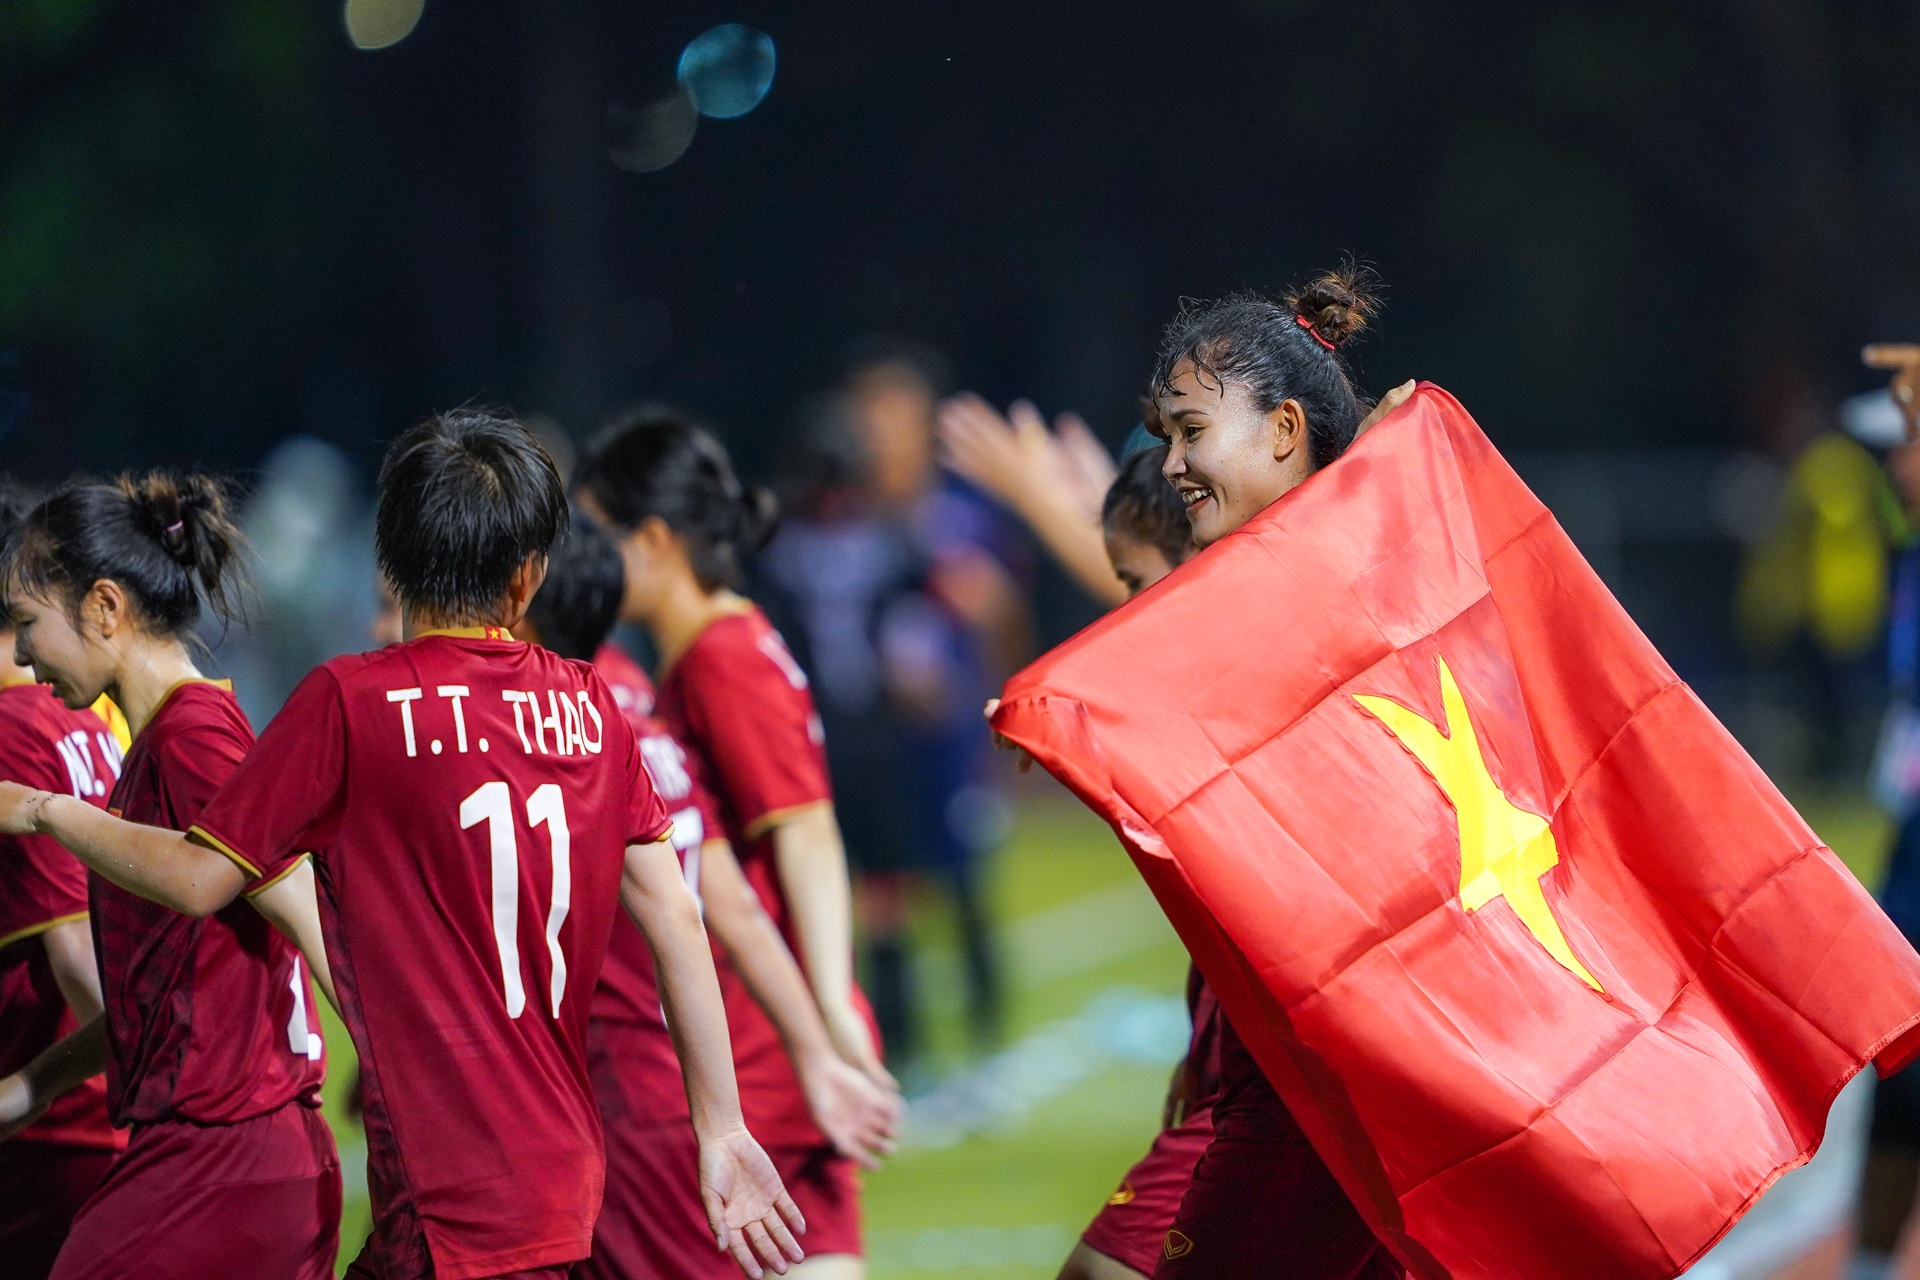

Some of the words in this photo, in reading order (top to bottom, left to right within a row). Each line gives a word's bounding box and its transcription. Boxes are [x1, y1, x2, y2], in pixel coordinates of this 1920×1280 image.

[386, 685, 489, 757] T.T.
[502, 689, 602, 755] THAO
[459, 781, 571, 1019] 11
